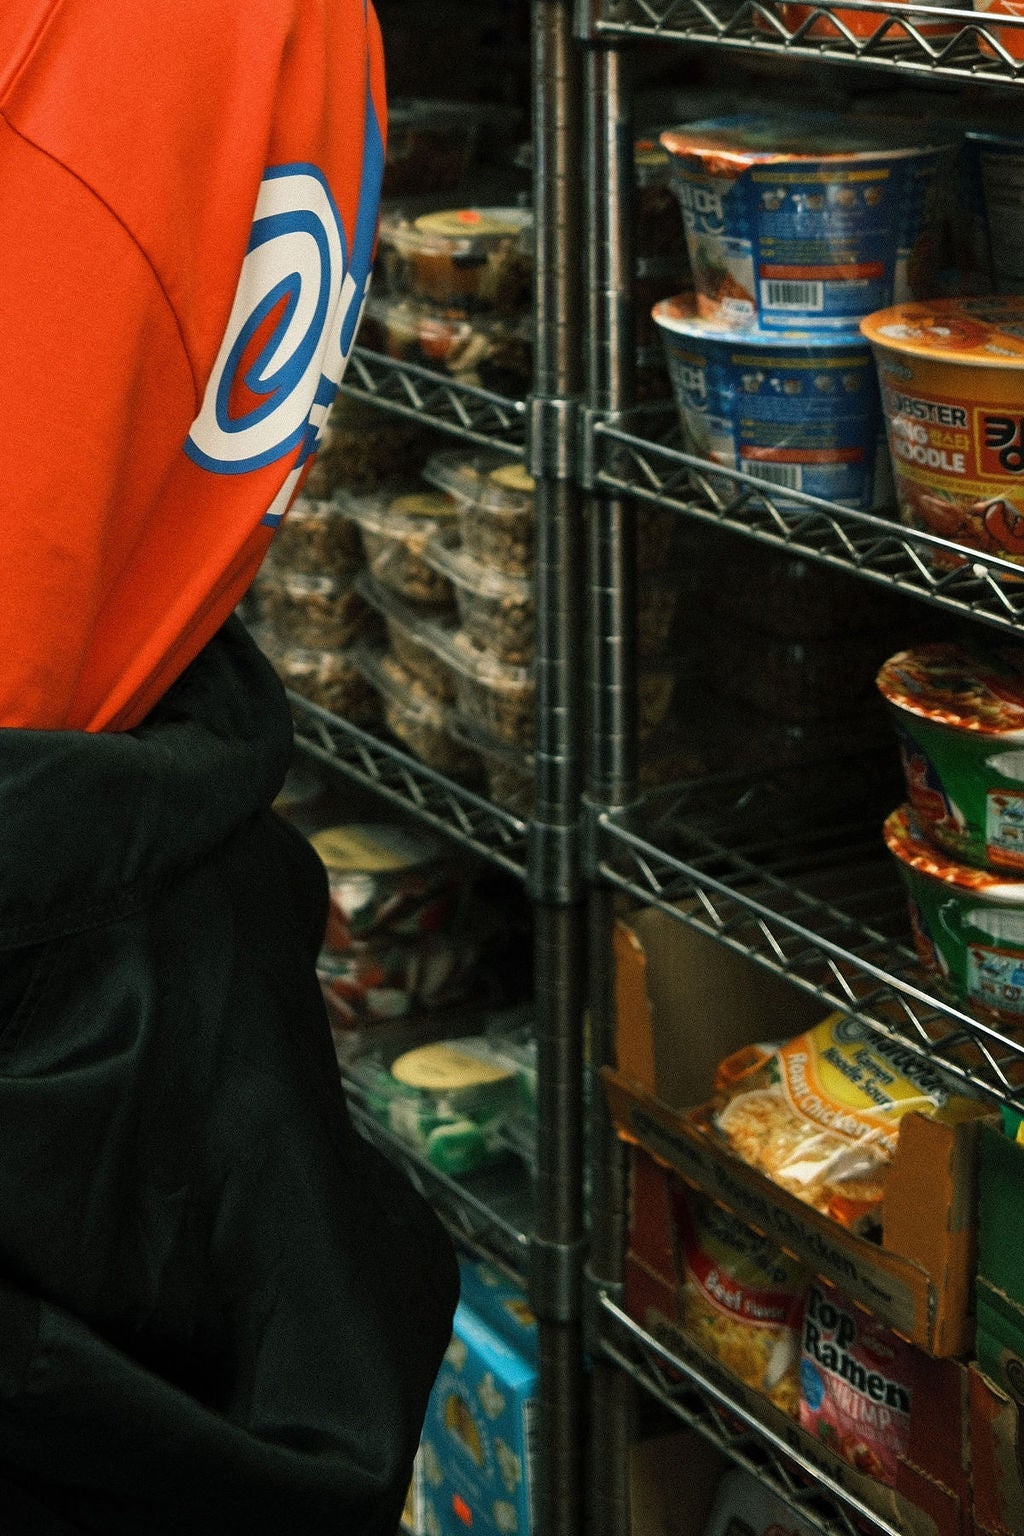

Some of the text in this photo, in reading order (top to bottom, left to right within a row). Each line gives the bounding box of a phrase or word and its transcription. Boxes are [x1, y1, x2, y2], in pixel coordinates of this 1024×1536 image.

[703, 1269, 743, 1312] Beef
[808, 1285, 856, 1350] Top
[805, 1317, 912, 1415] Ramen
